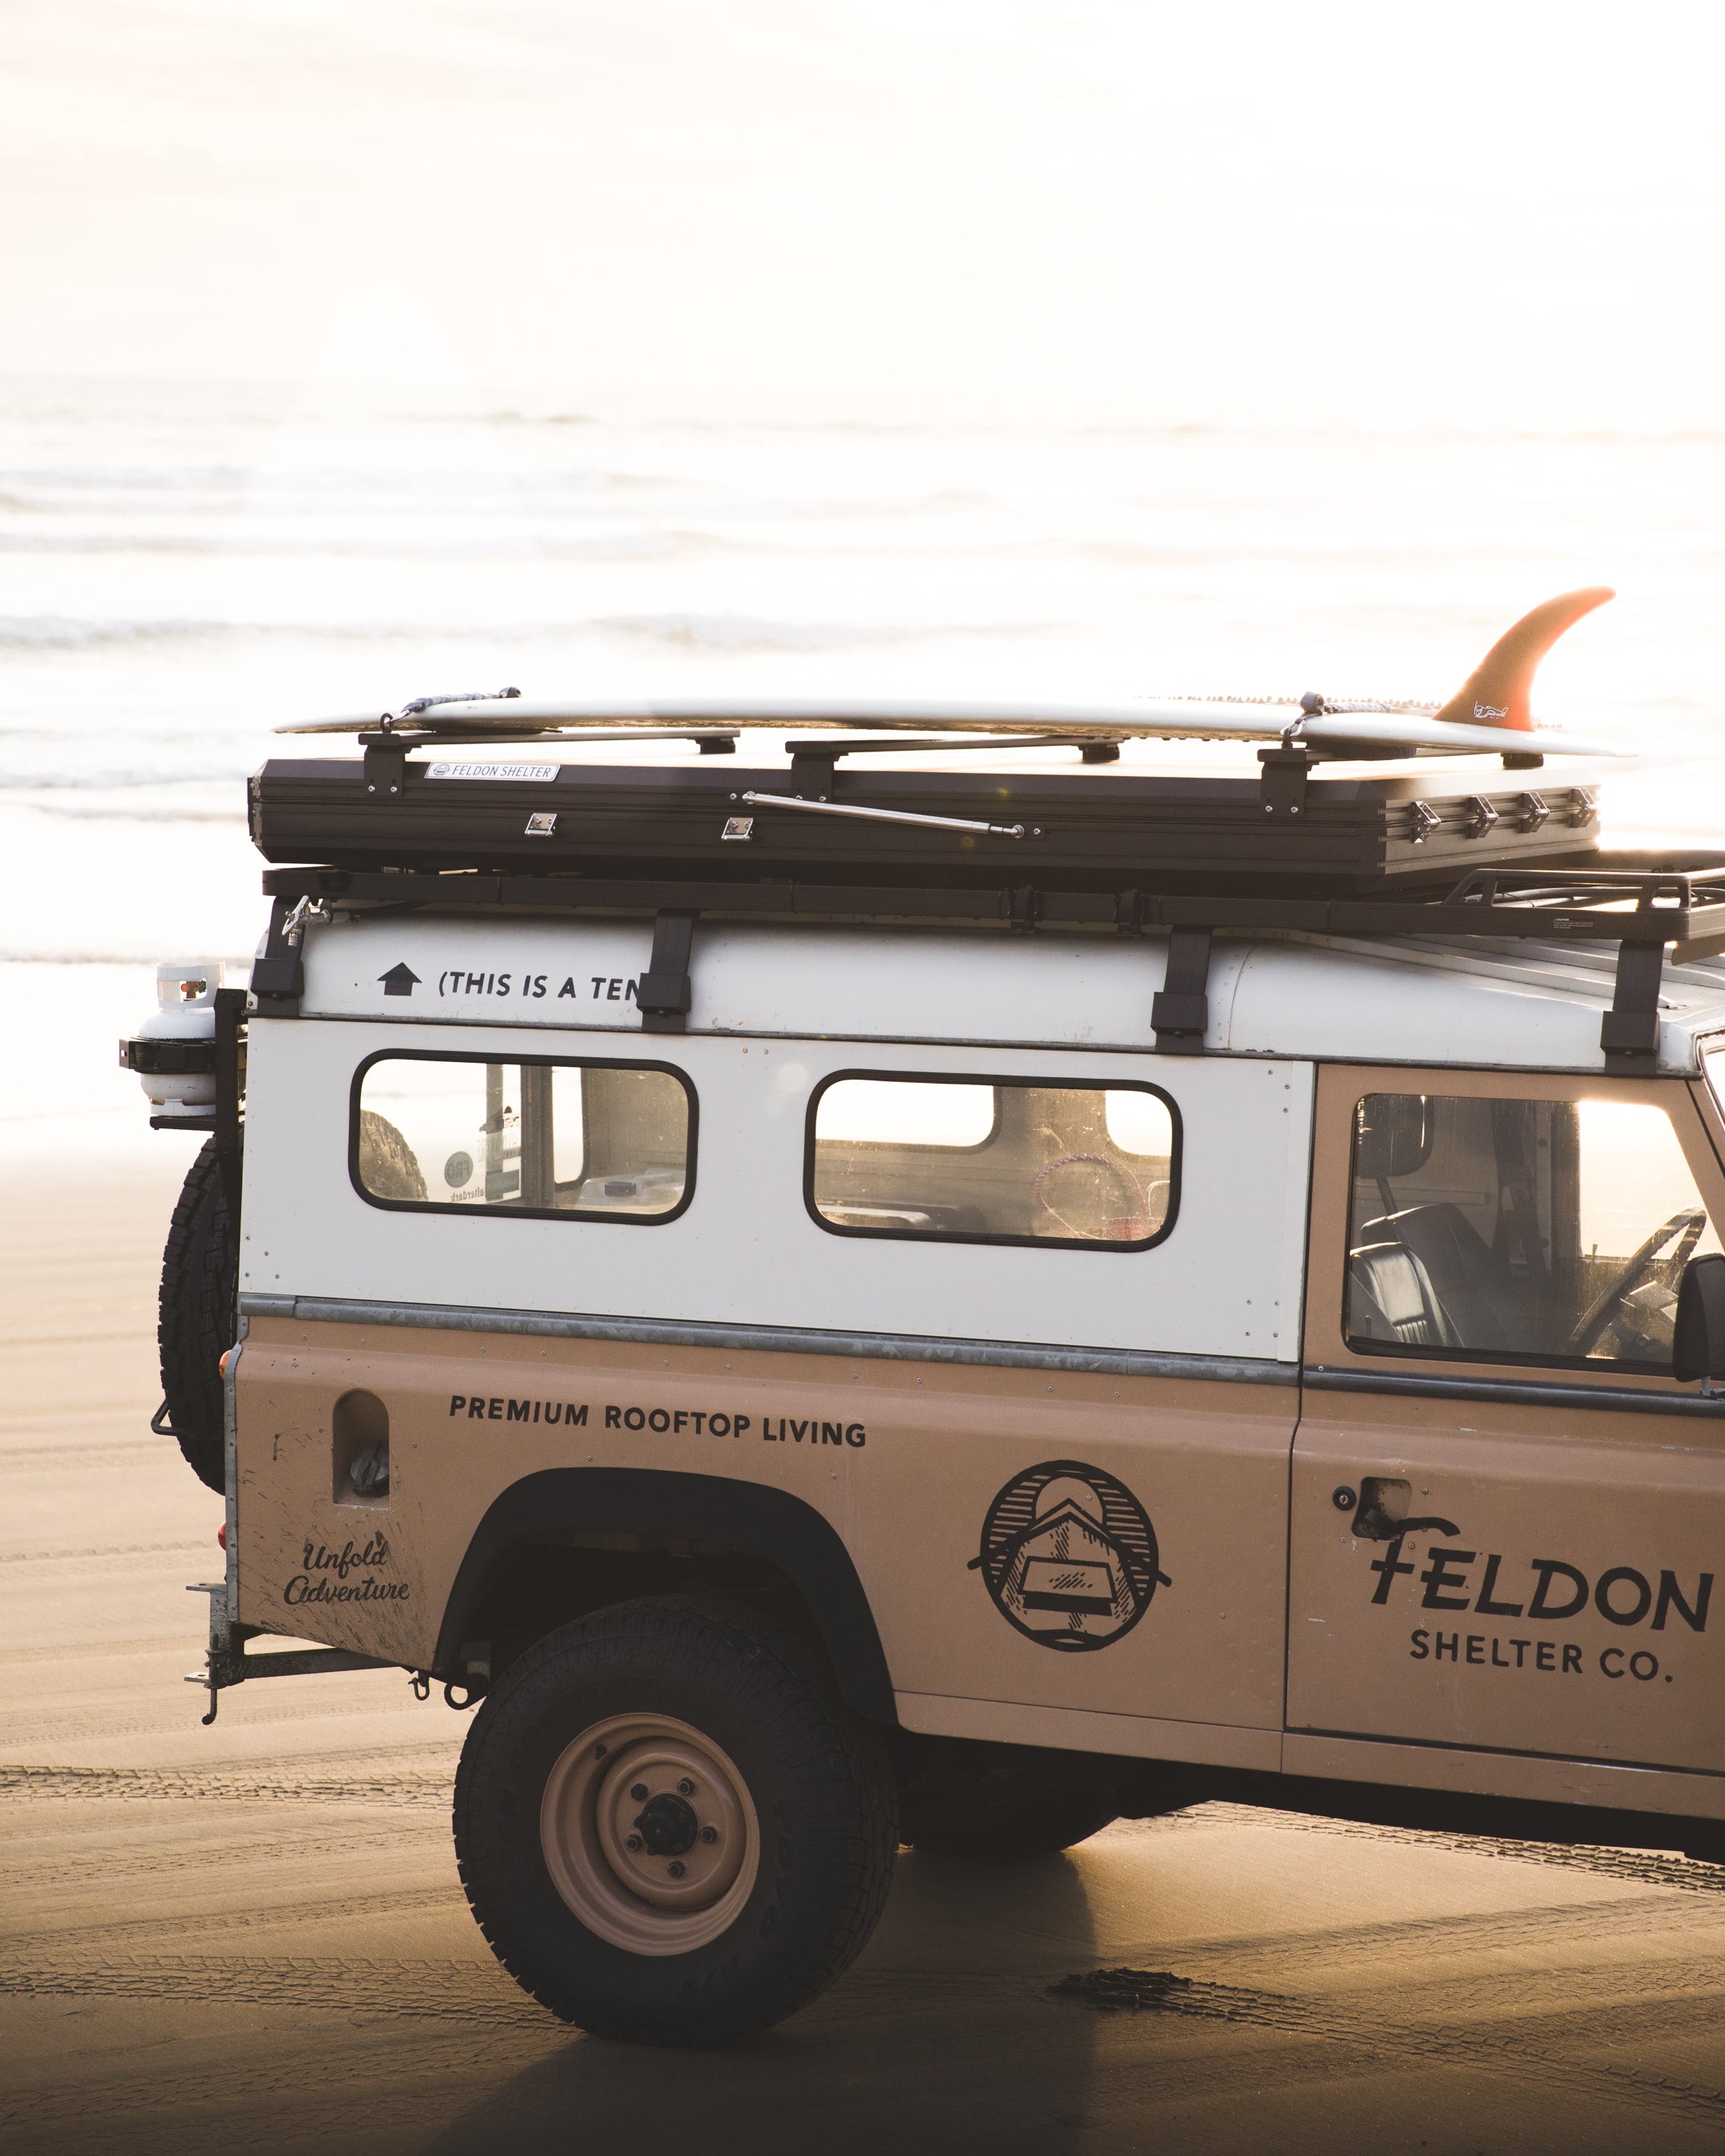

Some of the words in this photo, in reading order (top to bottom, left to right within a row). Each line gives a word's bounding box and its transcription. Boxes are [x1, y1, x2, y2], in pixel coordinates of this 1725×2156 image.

[452, 764, 499, 776] FELDON
[500, 765, 552, 778] SHELTER
[439, 971, 511, 997] (THIS
[522, 975, 548, 998] IS
[557, 977, 576, 998] A
[449, 1395, 589, 1426] PREMIUM
[605, 1405, 751, 1438] ROOFTOP
[763, 1417, 866, 1448] LIVING
[303, 1540, 389, 1579] Unfold
[1370, 1516, 1715, 1632] FELDON
[284, 1575, 410, 1605] Adventure
[1410, 1629, 1583, 1674] SHELTER
[1600, 1647, 1673, 1683] CO.
